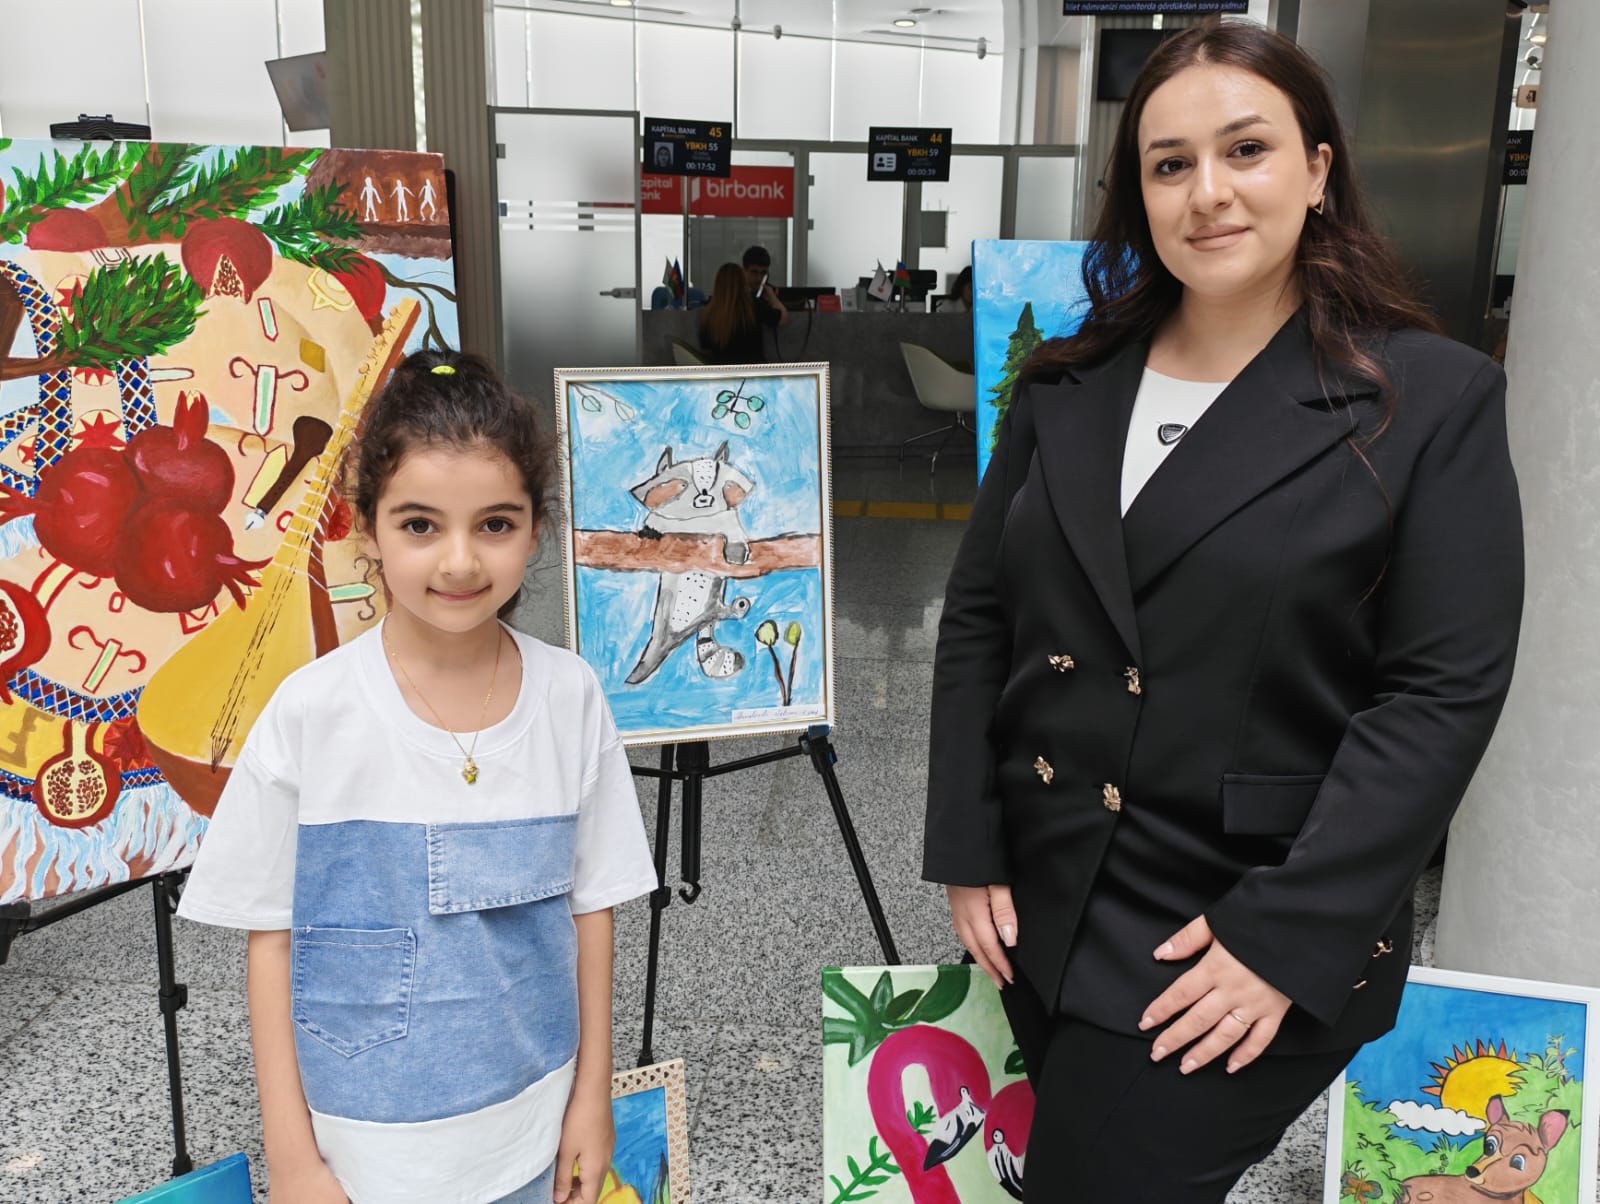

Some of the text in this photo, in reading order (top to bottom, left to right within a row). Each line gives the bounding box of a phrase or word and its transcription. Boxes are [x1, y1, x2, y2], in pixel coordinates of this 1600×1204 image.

[678, 127, 696, 135] BANK
[708, 127, 723, 138] 45
[930, 133, 942, 143] 44
[708, 142, 719, 151] 55
[929, 148, 939, 157] 59
[686, 162, 717, 171] 00:17:52
[640, 177, 672, 190] apital
[707, 180, 784, 199] birbank
[640, 190, 661, 200] ank
